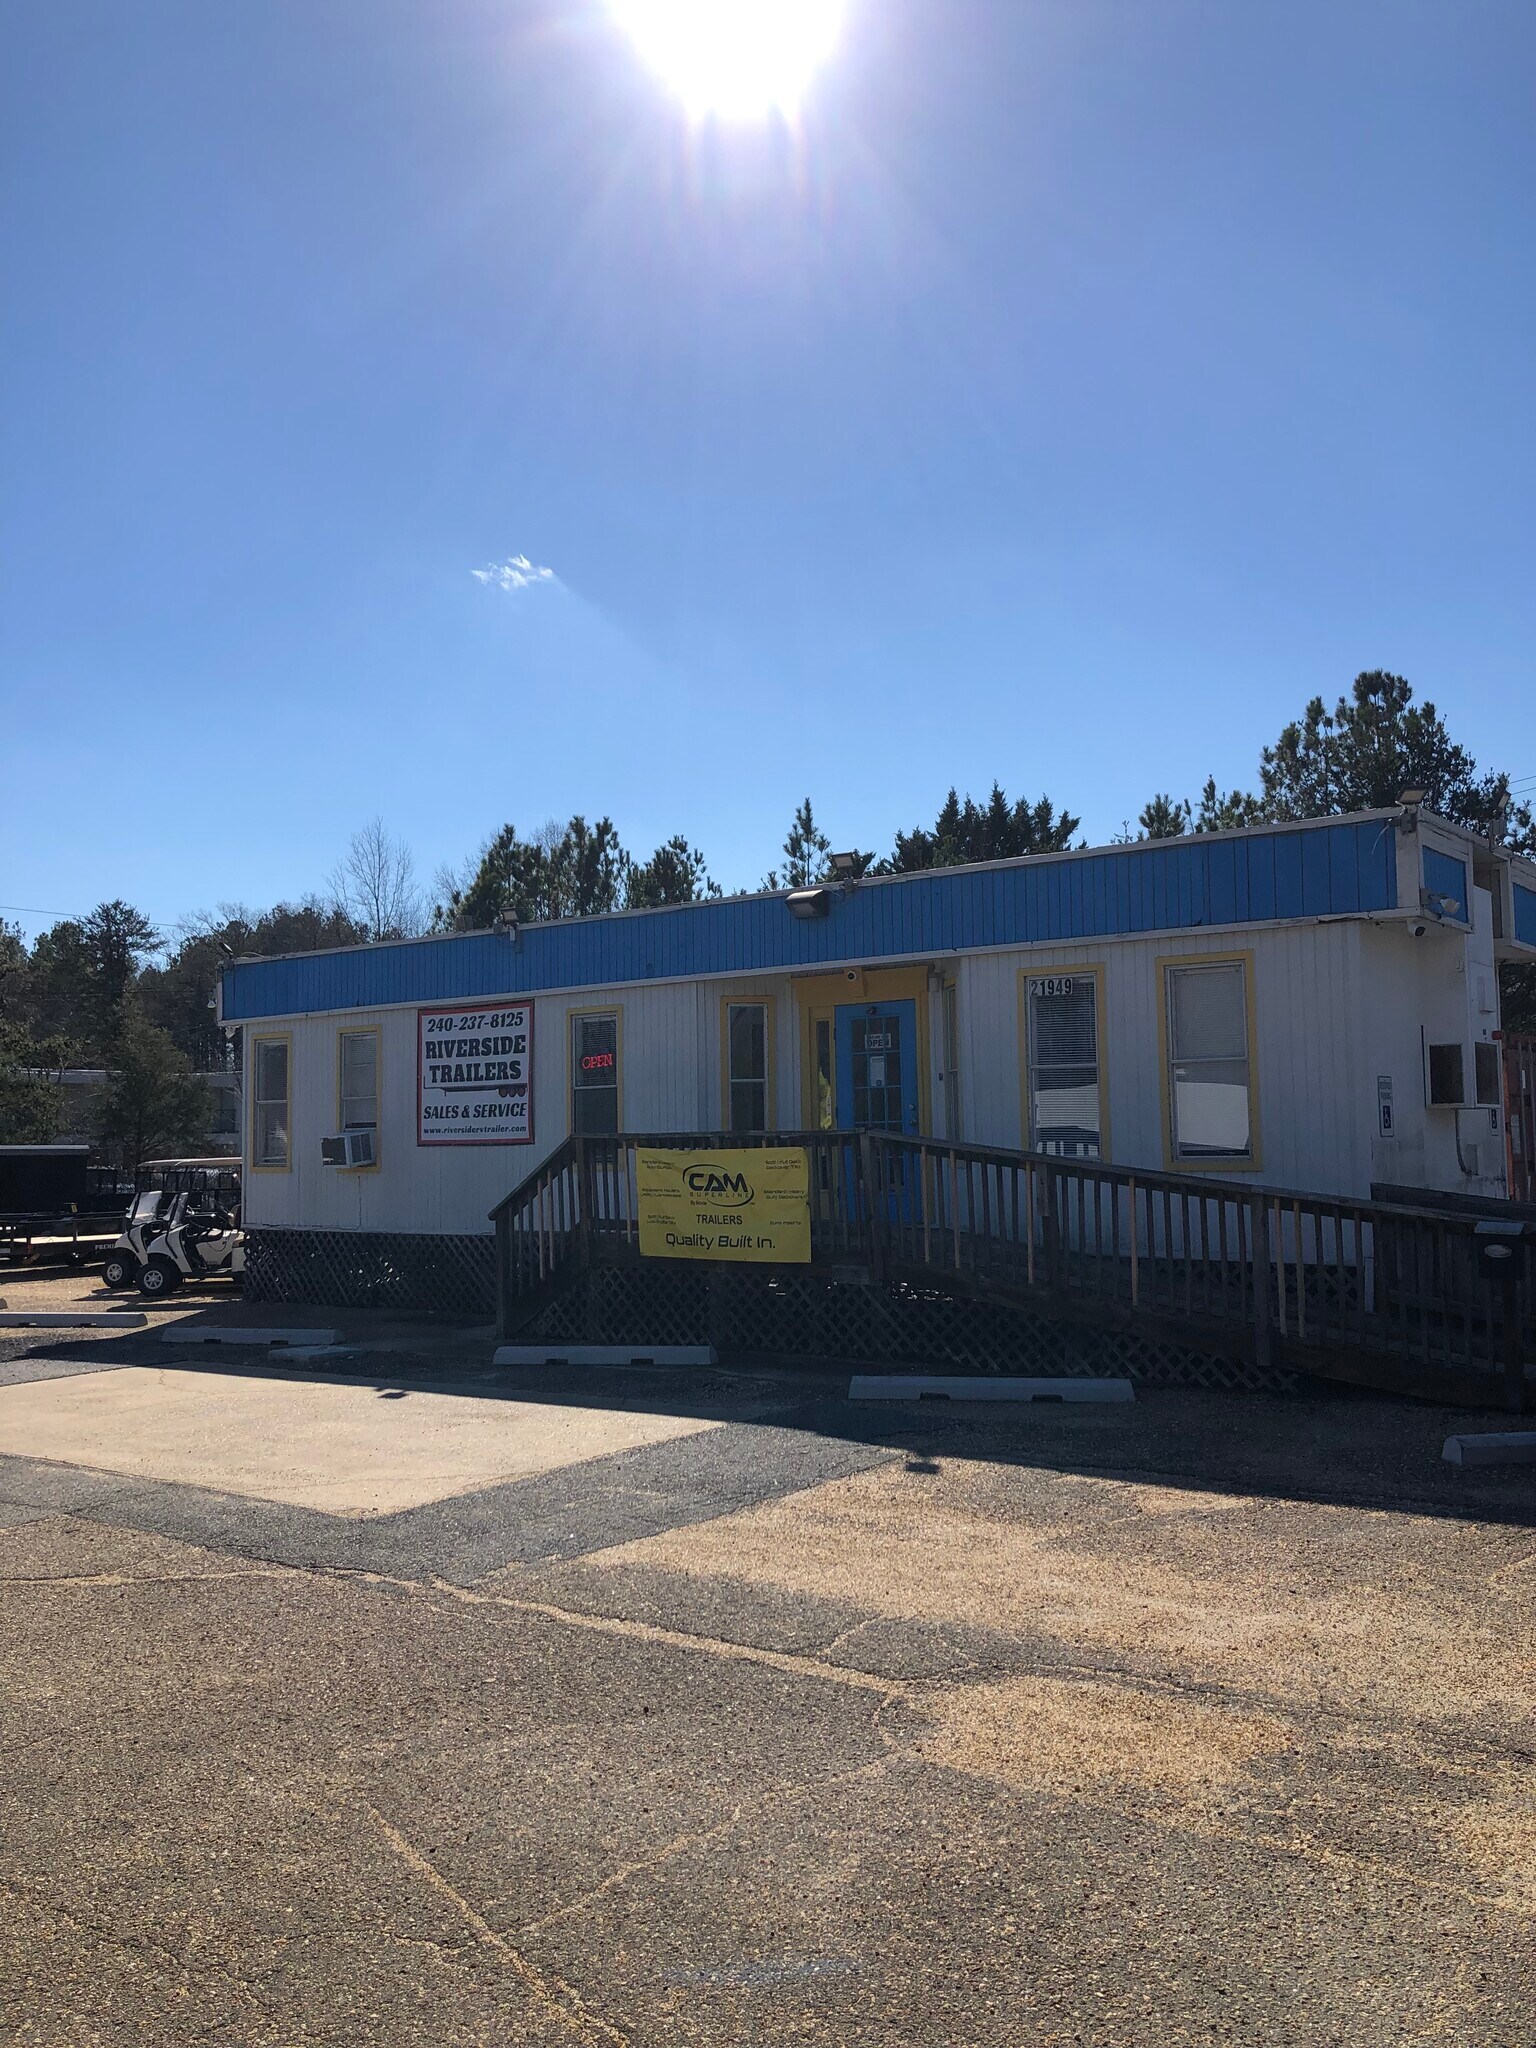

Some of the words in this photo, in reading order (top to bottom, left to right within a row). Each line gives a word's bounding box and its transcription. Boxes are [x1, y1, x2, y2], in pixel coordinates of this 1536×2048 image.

[1030, 978, 1072, 996] 21949
[427, 1012, 524, 1032] 240-237-8125
[425, 1035, 526, 1059] RIVERSIDE
[582, 1053, 613, 1069] OPEN
[429, 1060, 522, 1083] TRAILERS
[423, 1105, 459, 1119] SALES
[461, 1104, 470, 1119] &
[473, 1102, 527, 1118] SERVICE
[689, 1173, 748, 1192] CAM
[696, 1214, 743, 1225] TRAILERS
[666, 1233, 714, 1250] Quality
[718, 1235, 752, 1248] Built
[757, 1236, 776, 1249] In.
